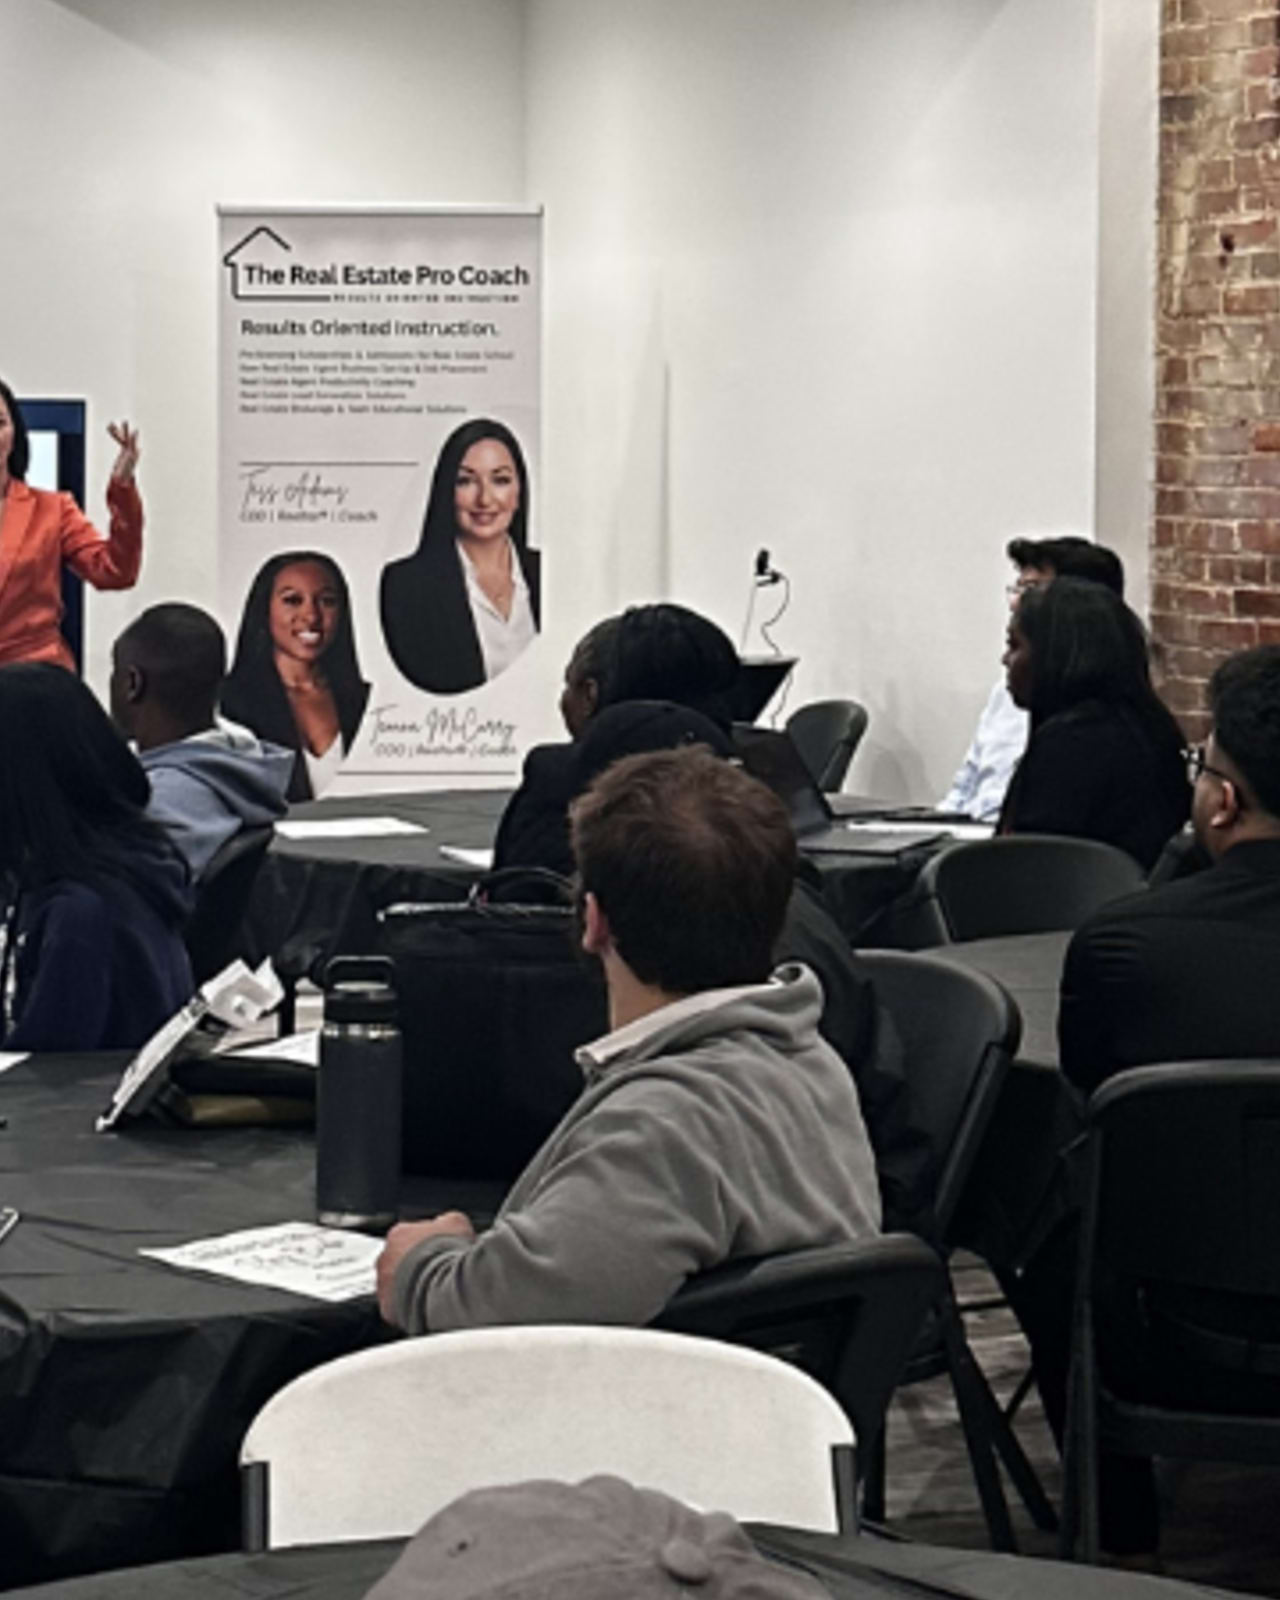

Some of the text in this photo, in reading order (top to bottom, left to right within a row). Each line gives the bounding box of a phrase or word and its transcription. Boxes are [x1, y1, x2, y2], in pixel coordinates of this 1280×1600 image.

[243, 264, 530, 287] The Real Estate Pro Coach
[241, 319, 306, 336] Results
[310, 319, 391, 336] Oriented
